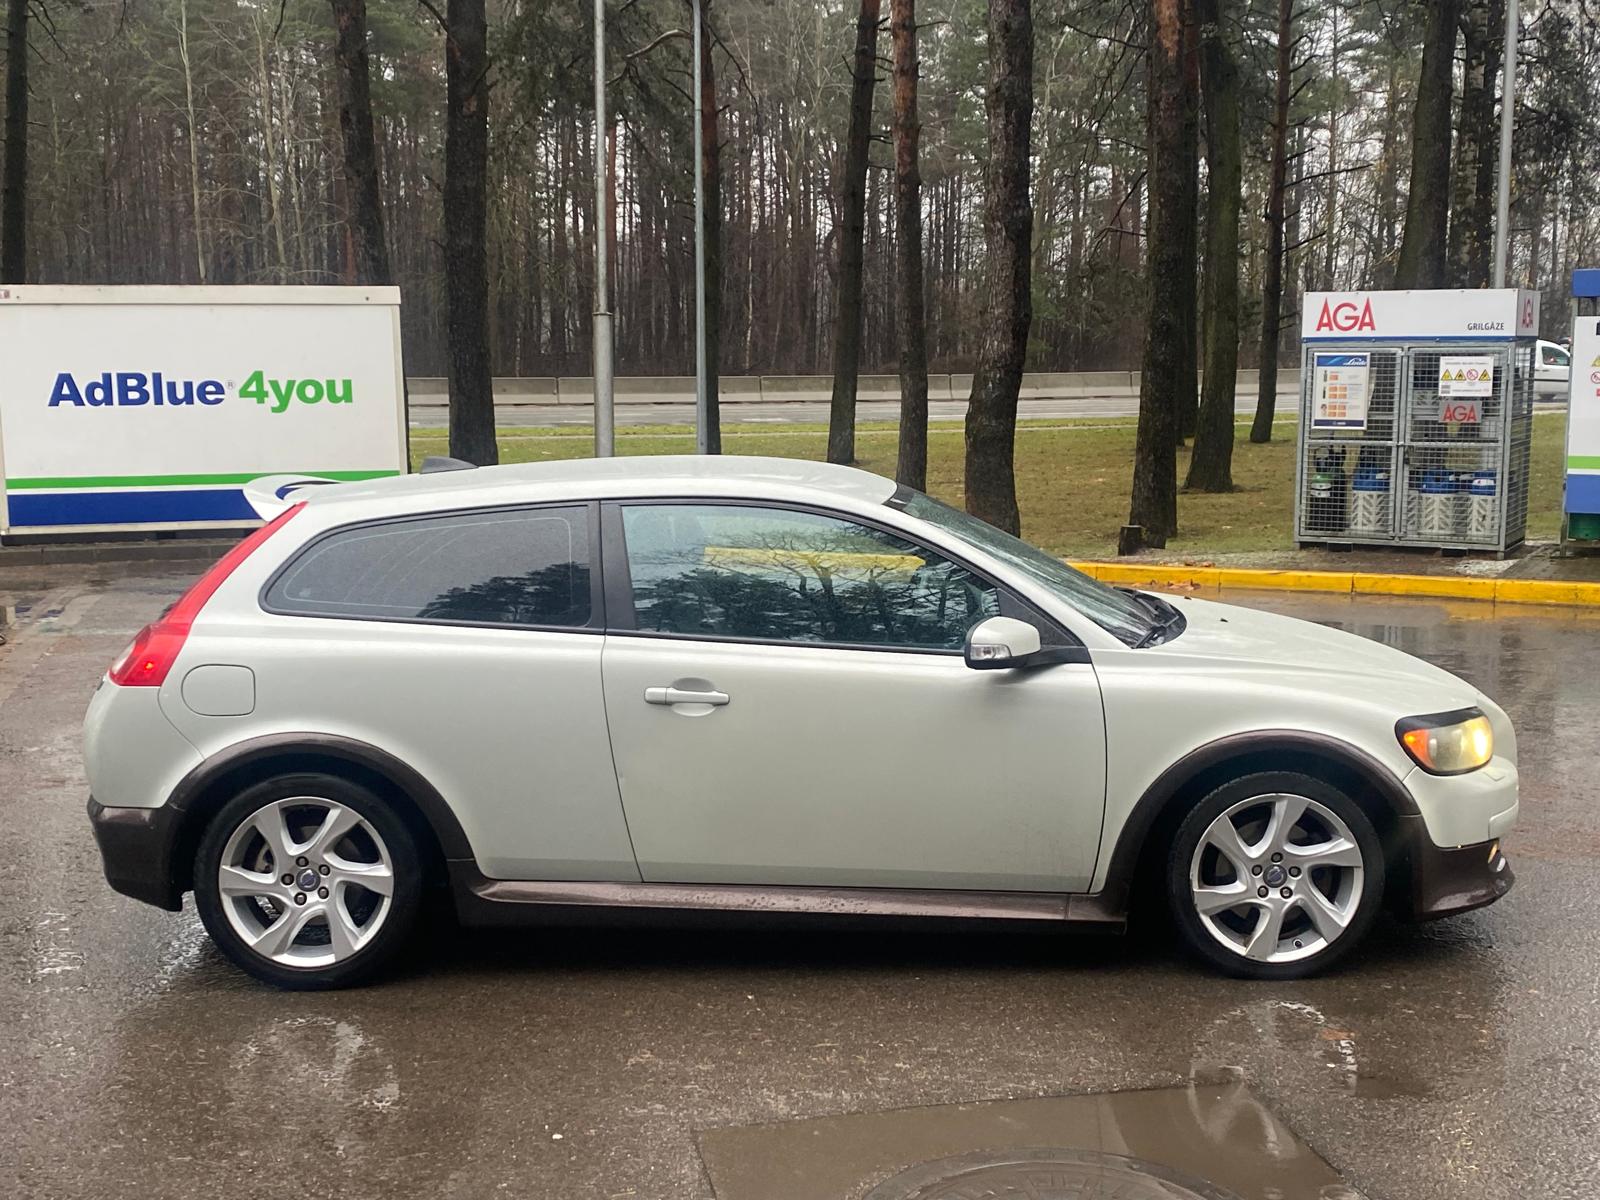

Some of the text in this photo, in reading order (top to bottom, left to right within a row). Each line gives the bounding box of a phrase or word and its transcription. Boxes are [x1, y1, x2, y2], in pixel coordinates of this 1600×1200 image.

[1316, 296, 1376, 331] AGA
[239, 370, 353, 413] 4you
[1443, 403, 1477, 422] AGA
